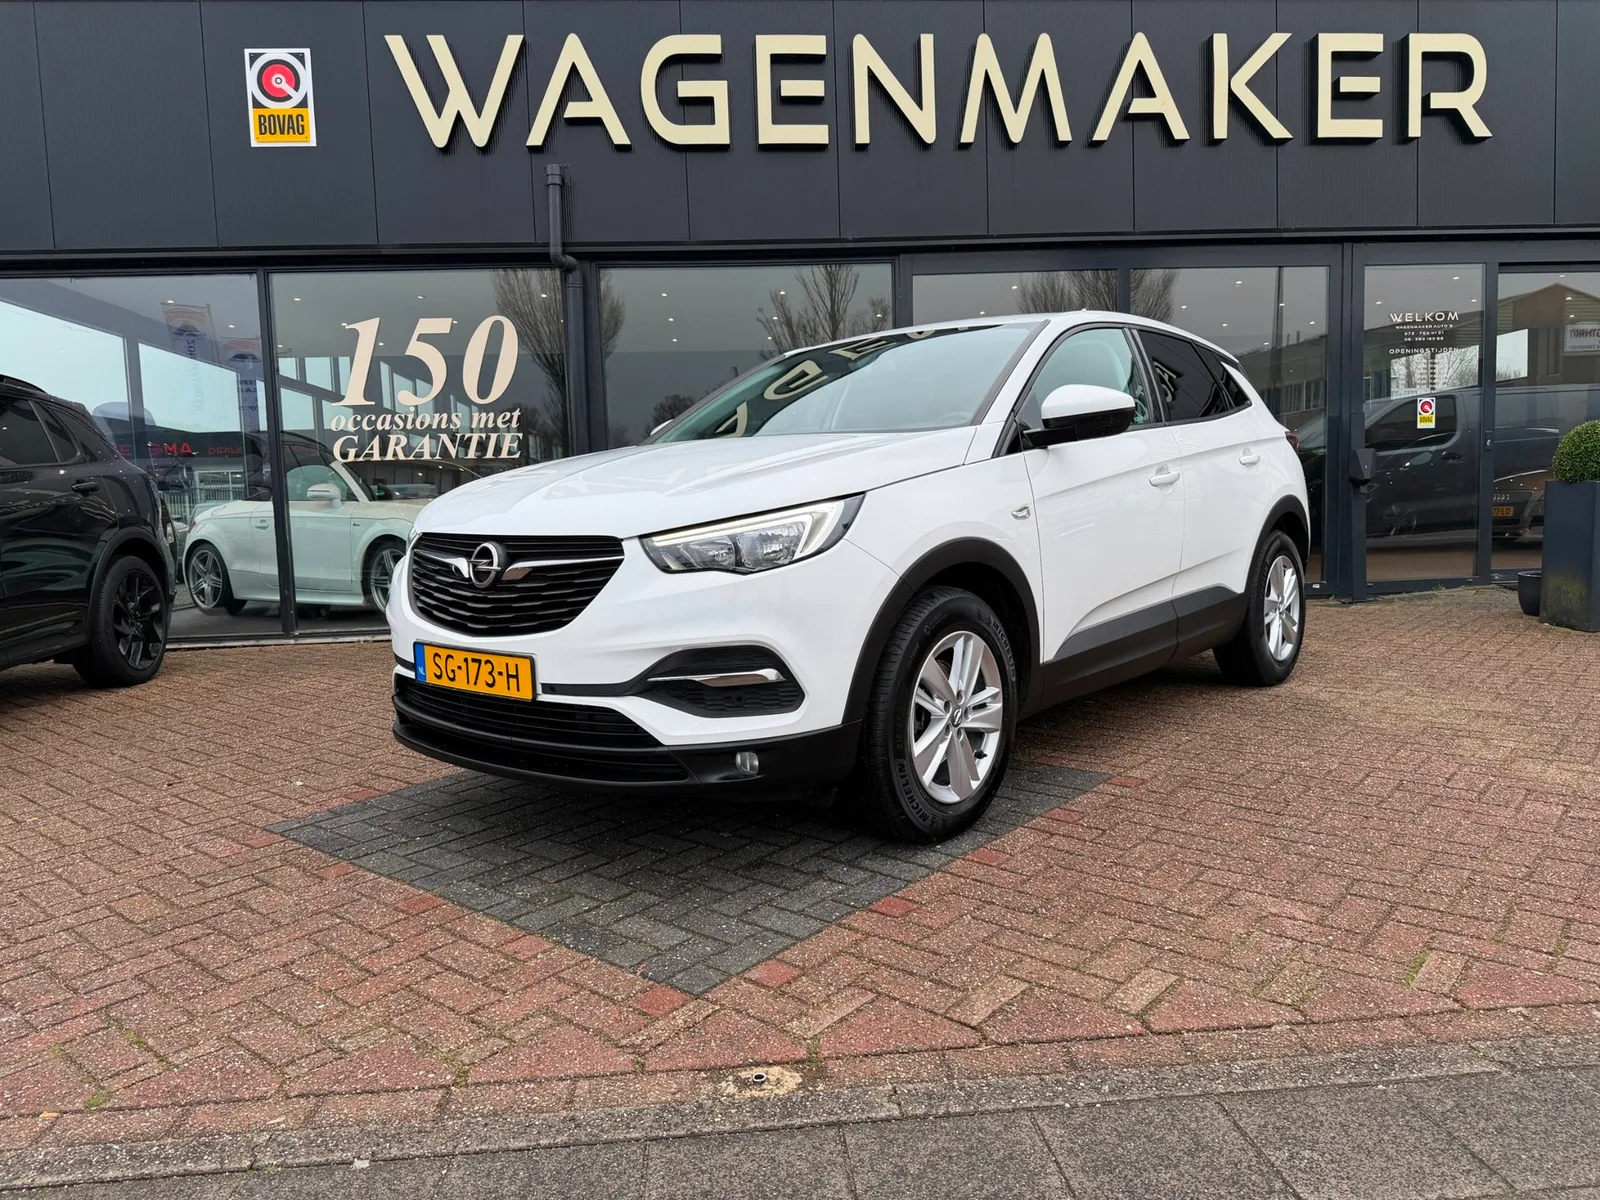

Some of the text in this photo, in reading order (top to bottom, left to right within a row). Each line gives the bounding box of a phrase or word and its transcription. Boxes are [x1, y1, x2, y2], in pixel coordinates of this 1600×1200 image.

[383, 31, 1493, 148] WAGENMAKER
[258, 114, 306, 136] BOVAG
[1390, 312, 1459, 322] WELKOM
[331, 315, 519, 406] 150
[330, 405, 522, 431] occasions met
[333, 432, 524, 463] GARANTIE
[432, 652, 520, 692] SG-173-H
[897, 762, 930, 823] MICHELIN
